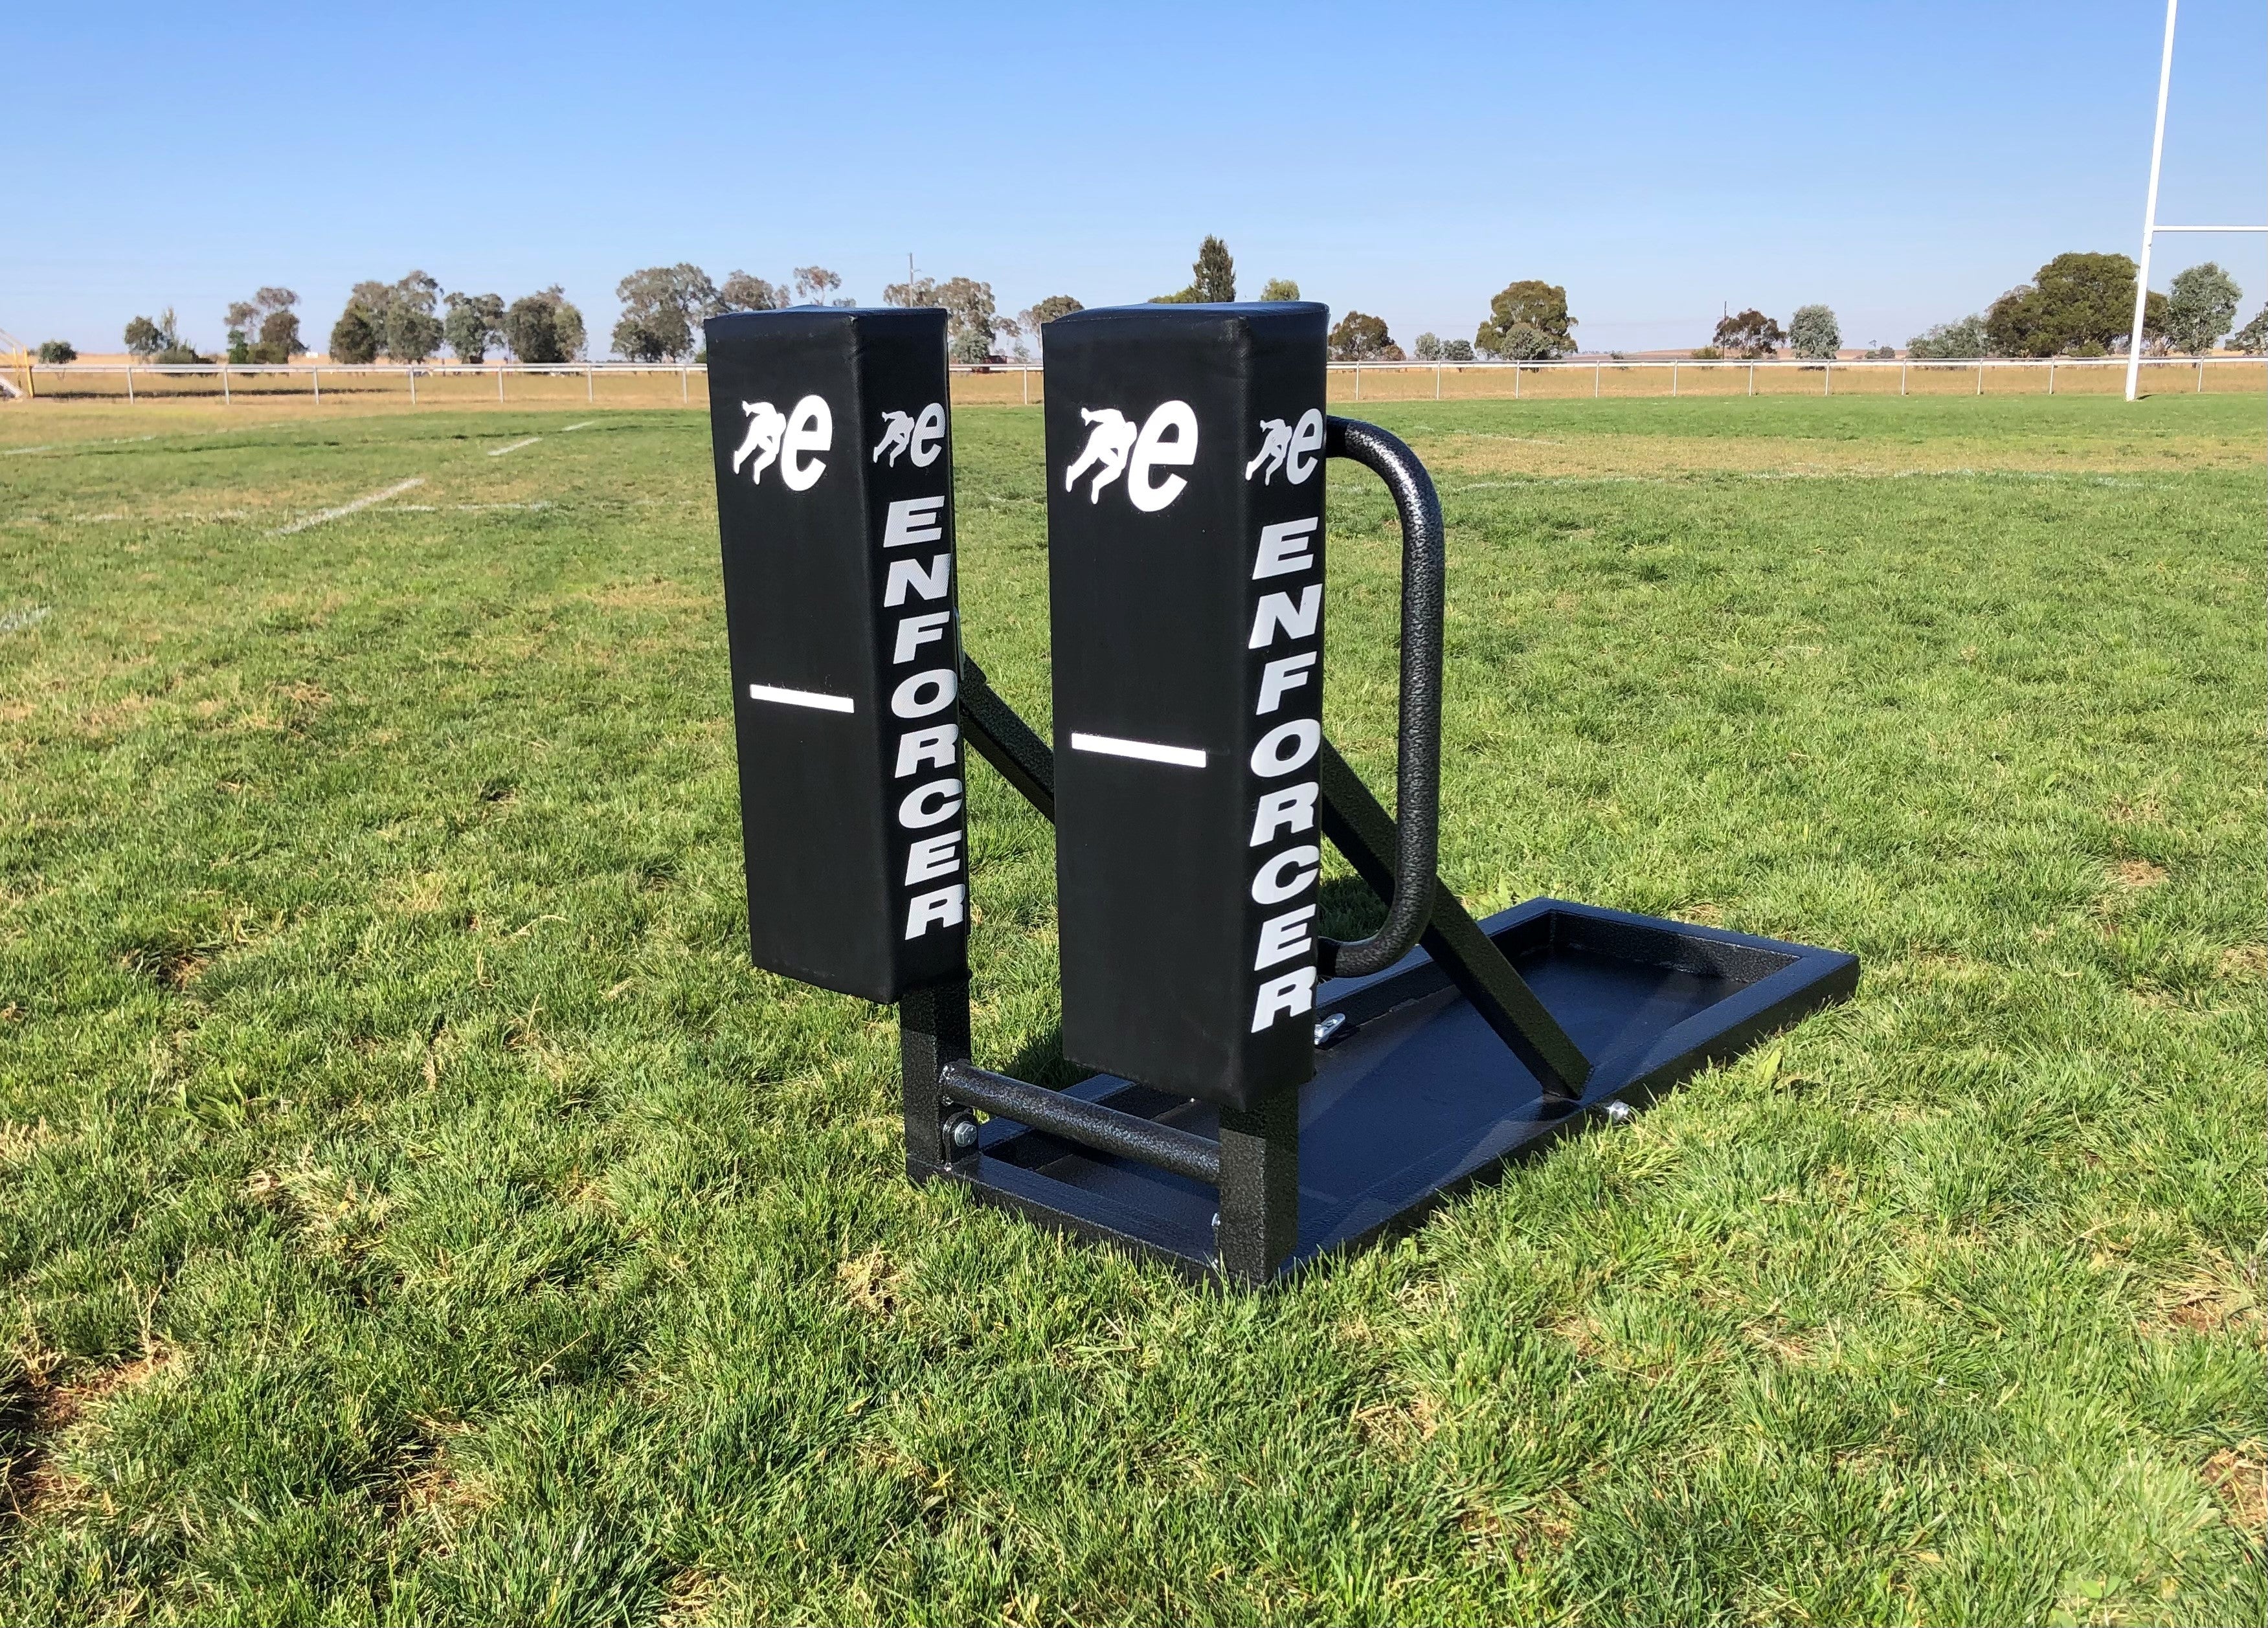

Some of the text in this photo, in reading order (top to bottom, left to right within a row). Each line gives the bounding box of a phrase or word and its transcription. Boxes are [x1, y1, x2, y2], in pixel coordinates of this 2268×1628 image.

[781, 394, 832, 491] e
[911, 402, 945, 467] e
[1127, 399, 1199, 513] e
[1287, 408, 1323, 485] e
[883, 495, 965, 941] ENFORCER
[1248, 517, 1321, 1034] ENFORCER
